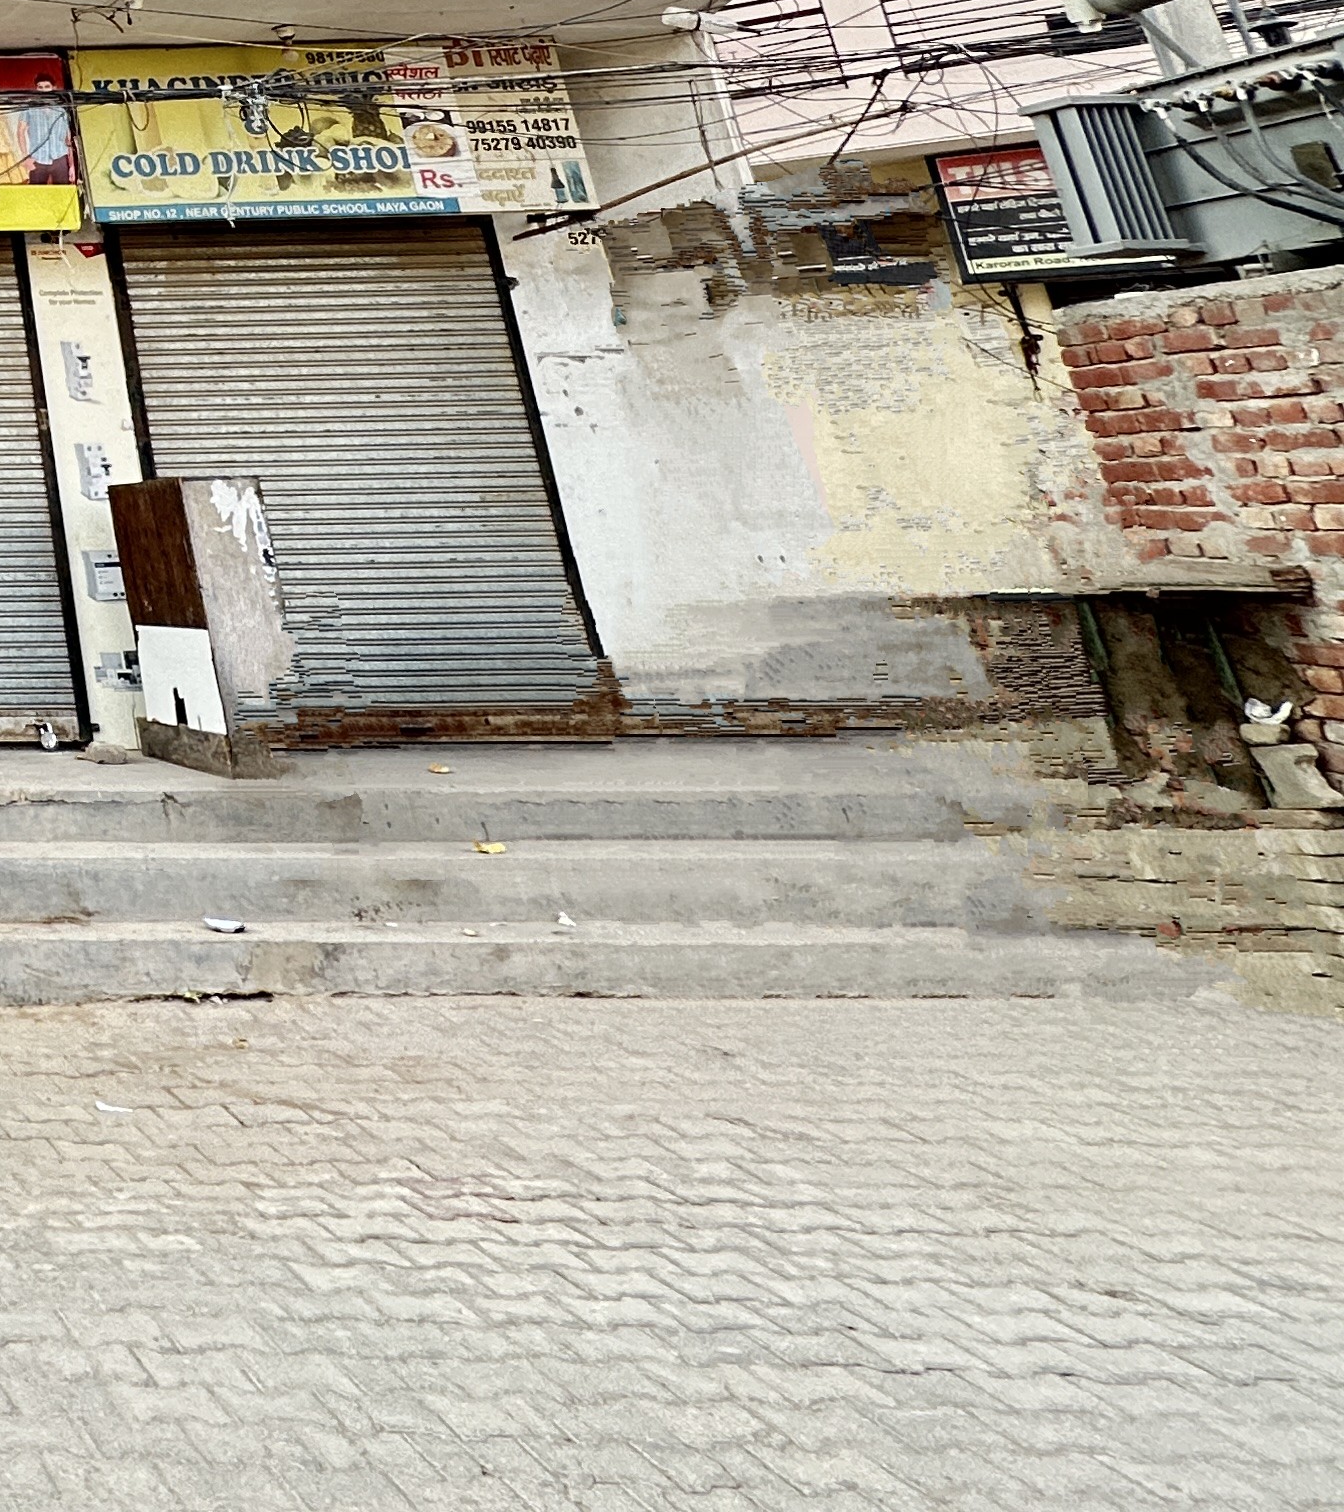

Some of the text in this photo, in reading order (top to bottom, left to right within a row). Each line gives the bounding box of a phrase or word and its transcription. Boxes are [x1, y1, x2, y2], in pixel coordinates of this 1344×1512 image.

[466, 117, 570, 134] 99155 14817
[470, 136, 521, 152] 75279
[112, 151, 201, 178] COLD
[210, 147, 325, 176] DRINK
[419, 168, 463, 189] Rs.
[109, 200, 445, 221] SHOP NO. NEAR CENTURY PUBLIC SCHOOL, NAYA GAON
[974, 256, 1031, 270] Karoran
